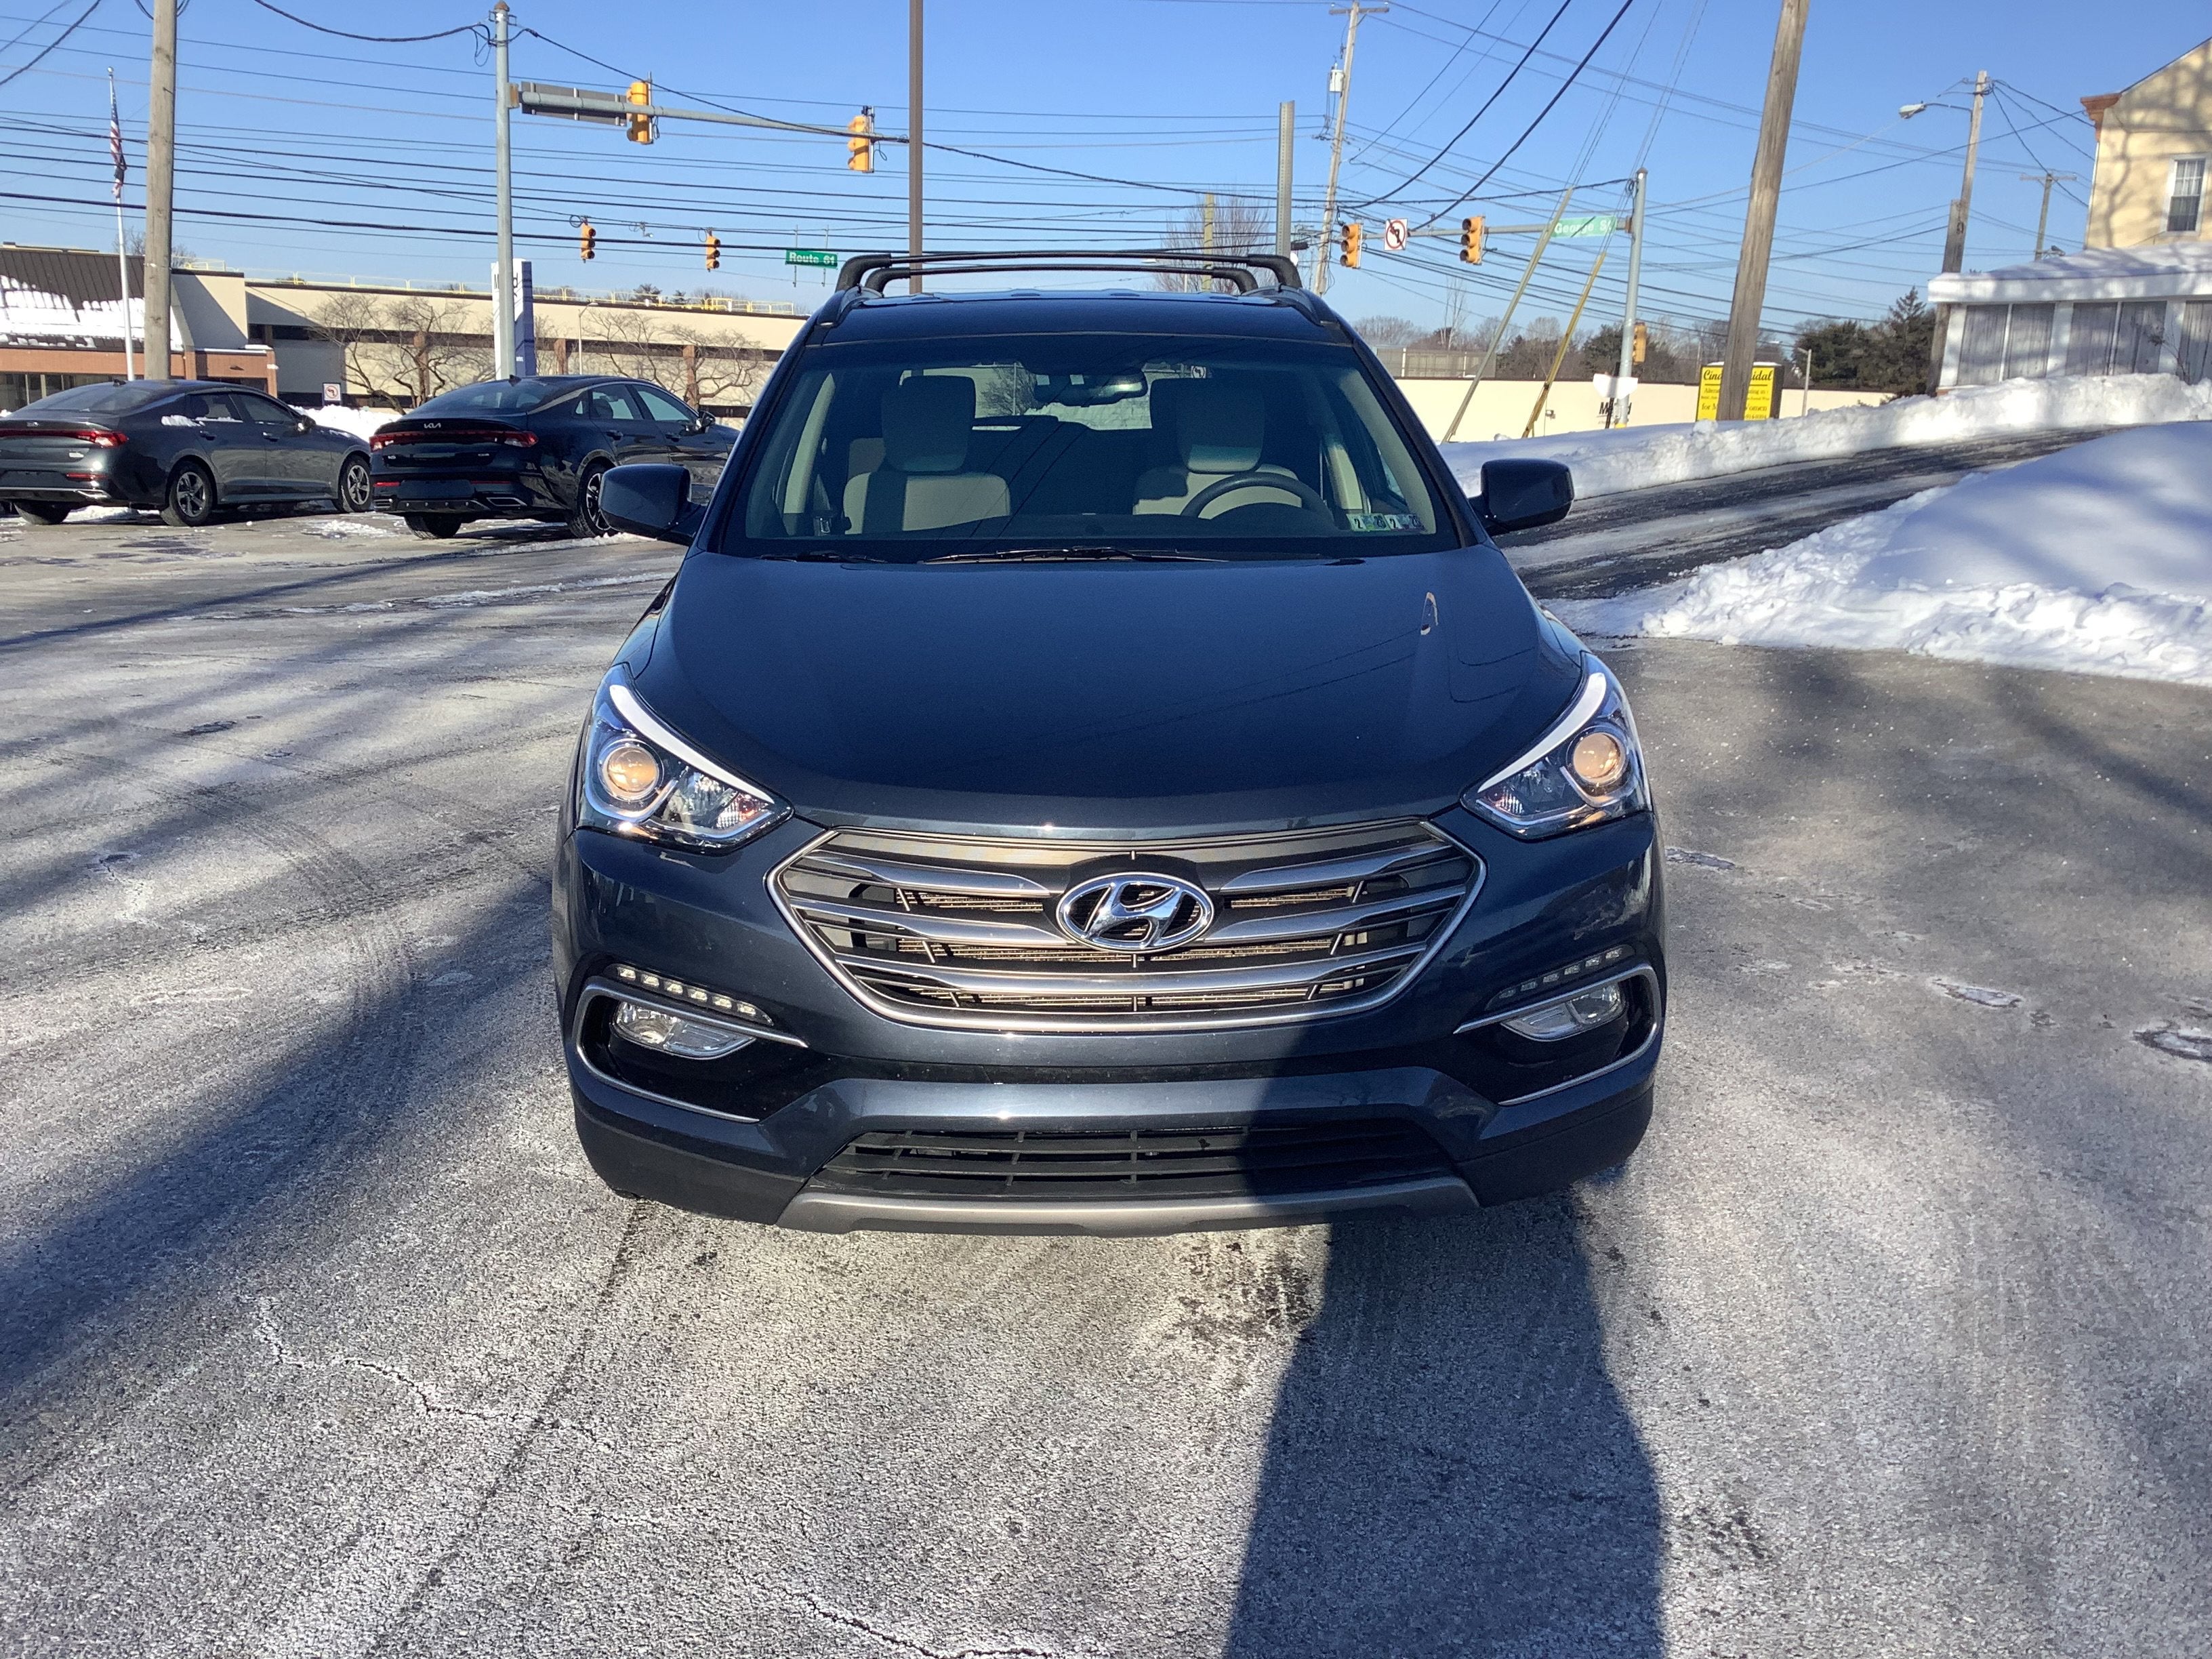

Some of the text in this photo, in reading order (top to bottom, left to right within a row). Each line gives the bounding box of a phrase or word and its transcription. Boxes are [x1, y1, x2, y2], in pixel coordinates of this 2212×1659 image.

[1554, 222, 1595, 234] George
[789, 251, 819, 263] Route
[1752, 371, 1772, 381] idal
